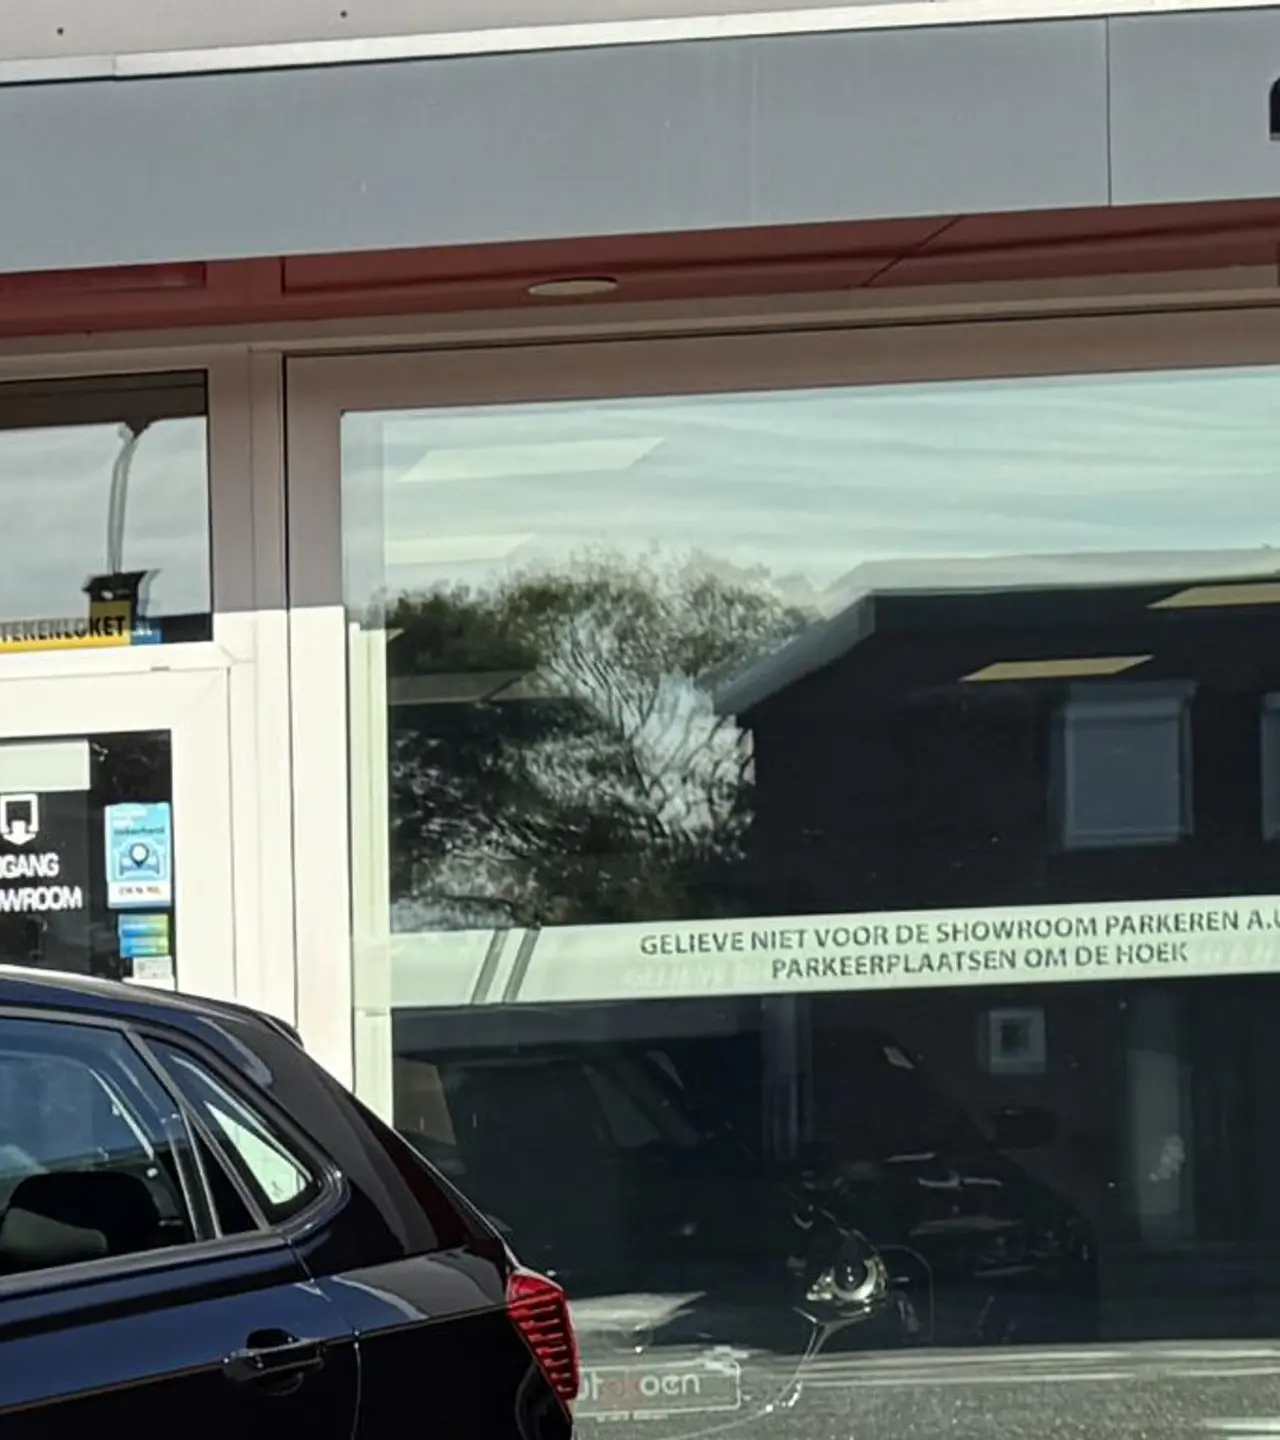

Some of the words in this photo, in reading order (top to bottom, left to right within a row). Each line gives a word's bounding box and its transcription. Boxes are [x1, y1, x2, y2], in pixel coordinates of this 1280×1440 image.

[640, 931, 744, 955] GELIEVE
[751, 928, 808, 951] NIET
[814, 925, 890, 949] VOOR
[896, 922, 930, 945] DE
[936, 916, 1098, 943] SHOWROOM
[1104, 911, 1240, 937] PARKEREN
[771, 948, 1017, 980] PARKEERPLAATSEN
[1024, 948, 1068, 969] OM
[1075, 944, 1109, 966] DE
[1116, 942, 1189, 964] HOEK
